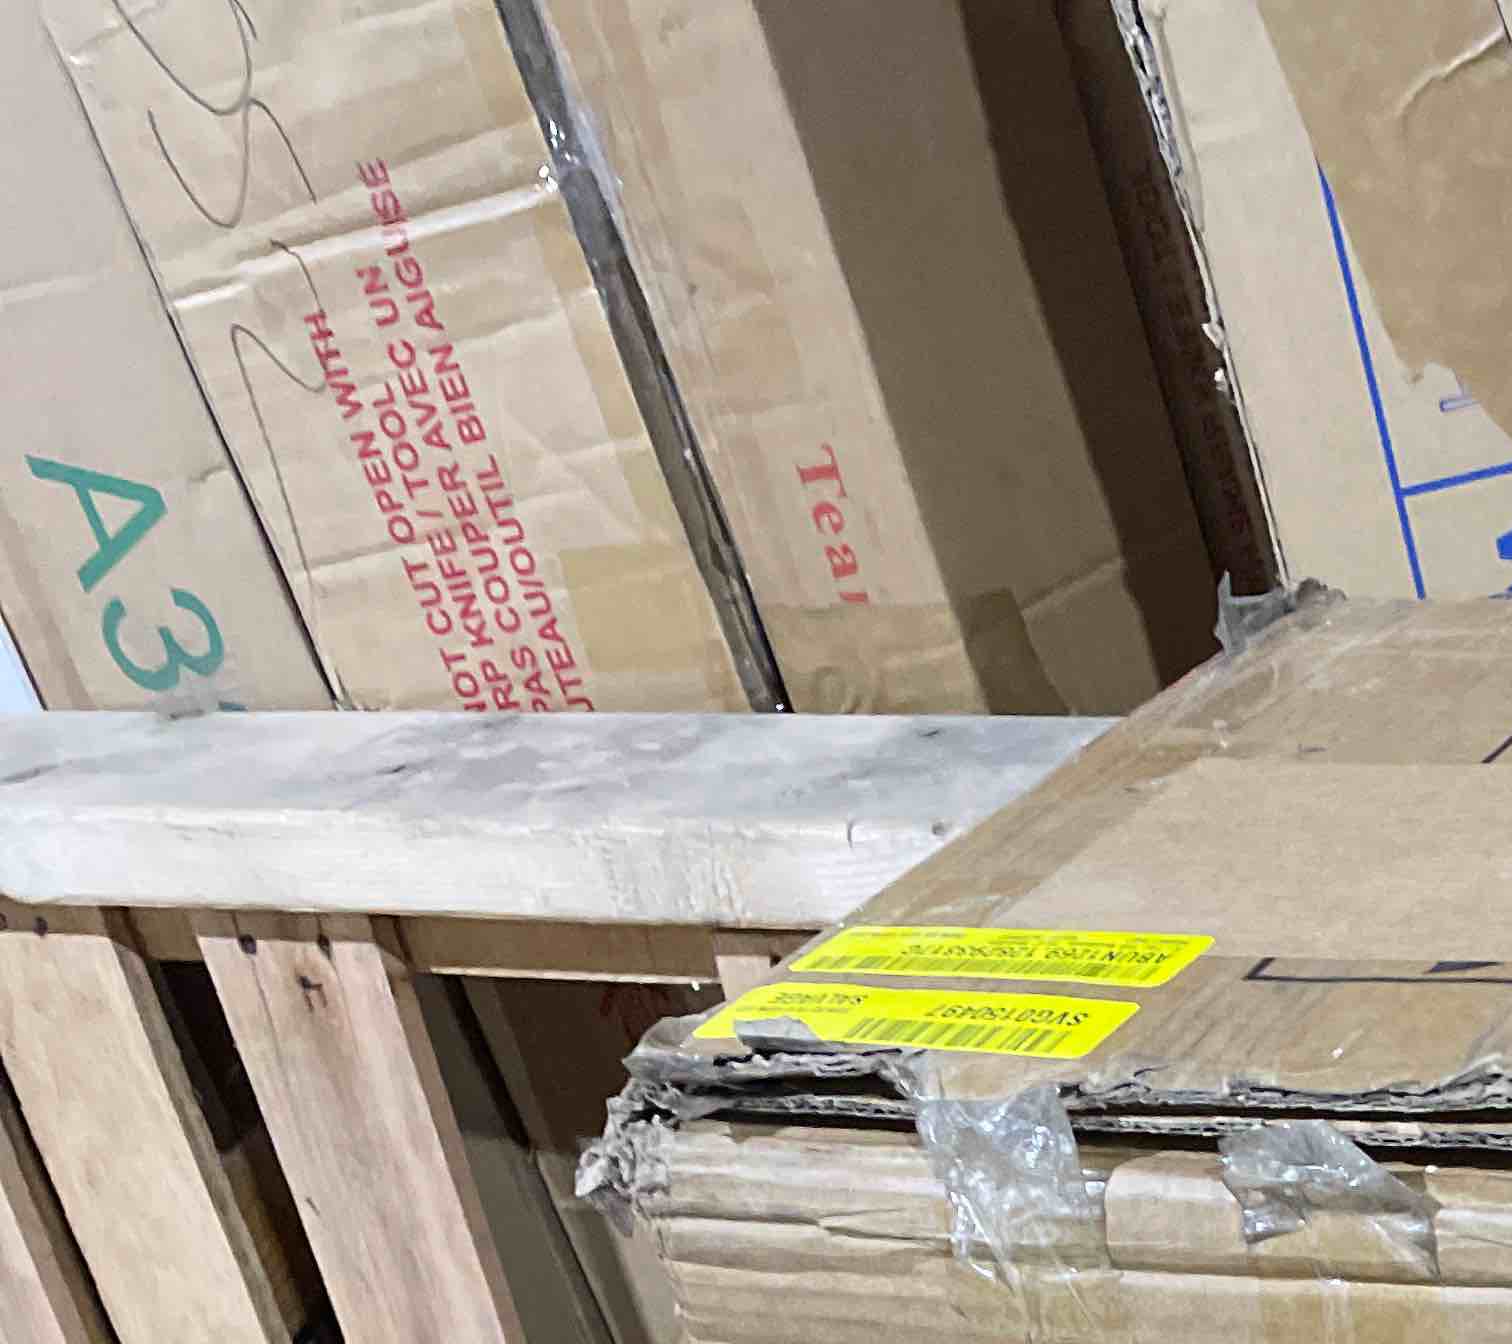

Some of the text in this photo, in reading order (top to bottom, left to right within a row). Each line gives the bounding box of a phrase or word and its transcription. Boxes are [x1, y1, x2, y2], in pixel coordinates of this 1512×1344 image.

[355, 265, 400, 328] UN
[304, 311, 363, 419] WITH
[387, 339, 453, 452] AVEC
[428, 343, 487, 445] BIEN
[350, 431, 416, 544] OPEN
[373, 381, 429, 500] TOOL
[416, 510, 445, 518] /
[438, 461, 521, 634] COUPER
[24, 453, 248, 711] A3
[401, 556, 452, 635] CUT
[427, 528, 494, 648] KNIFE
